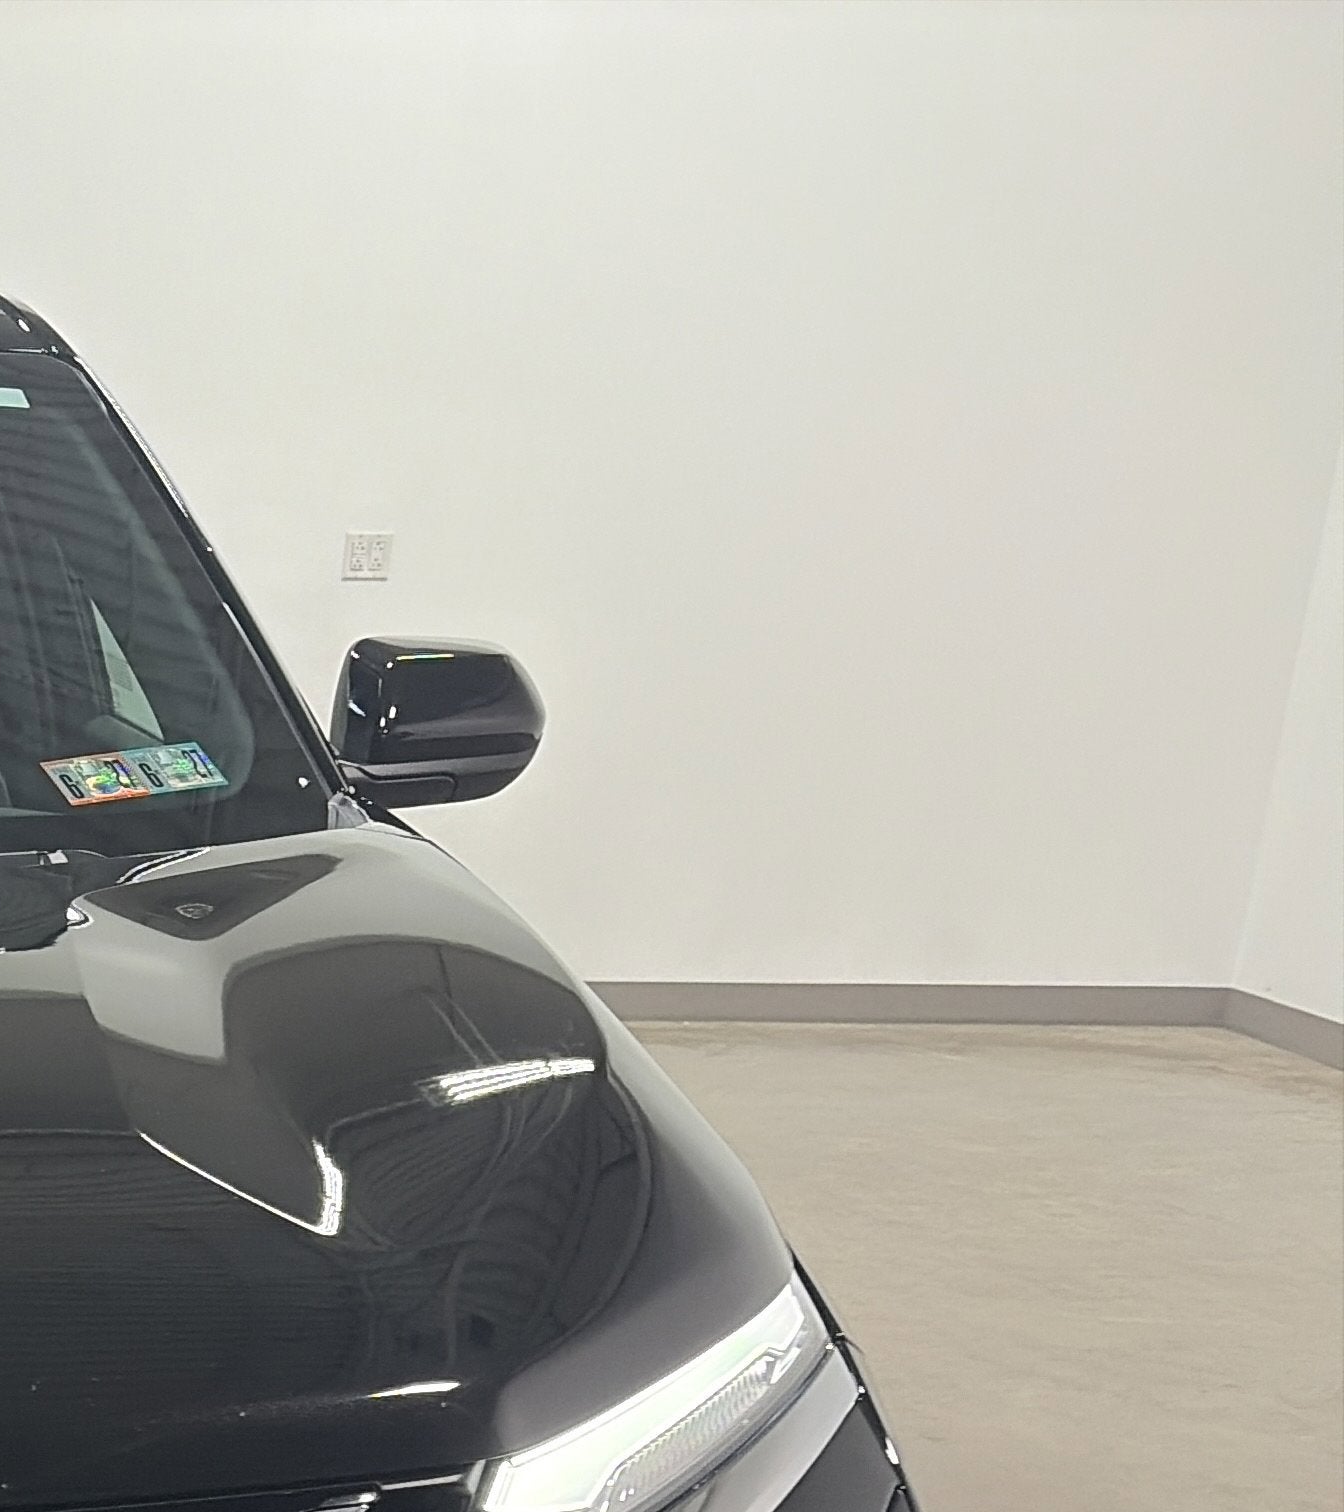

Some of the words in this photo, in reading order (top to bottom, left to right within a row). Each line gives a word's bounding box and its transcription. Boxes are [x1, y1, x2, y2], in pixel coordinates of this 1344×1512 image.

[139, 763, 164, 788] 6
[182, 750, 213, 778] 27
[59, 774, 84, 798] 6
